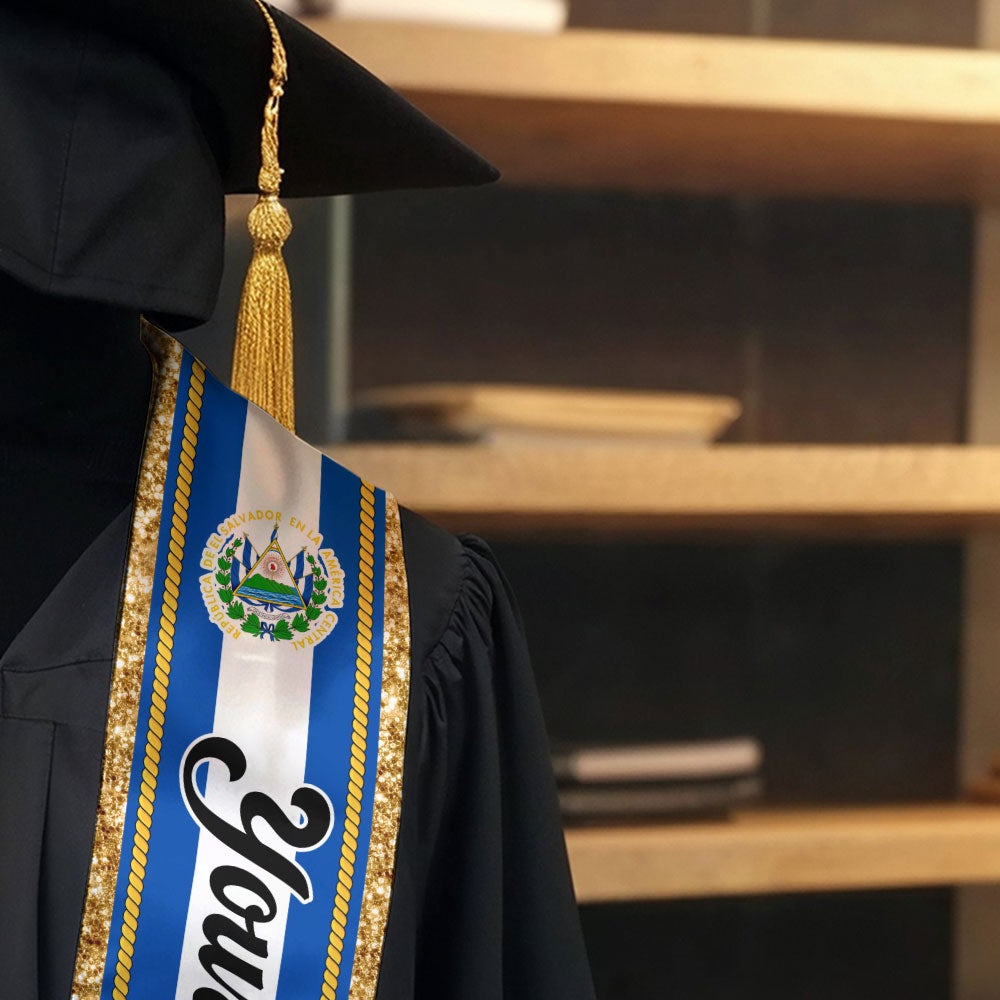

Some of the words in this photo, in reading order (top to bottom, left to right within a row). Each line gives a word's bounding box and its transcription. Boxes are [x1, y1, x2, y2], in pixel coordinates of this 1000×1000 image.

[220, 509, 282, 536] SALVADOR
[289, 516, 306, 533] EN
[210, 534, 223, 550] EL
[306, 530, 321, 547] LA
[202, 551, 215, 568] DE
[322, 550, 342, 607] AMÉRICA
[202, 575, 240, 640] REPÚBLICA
[291, 613, 336, 651] CENTRAL
